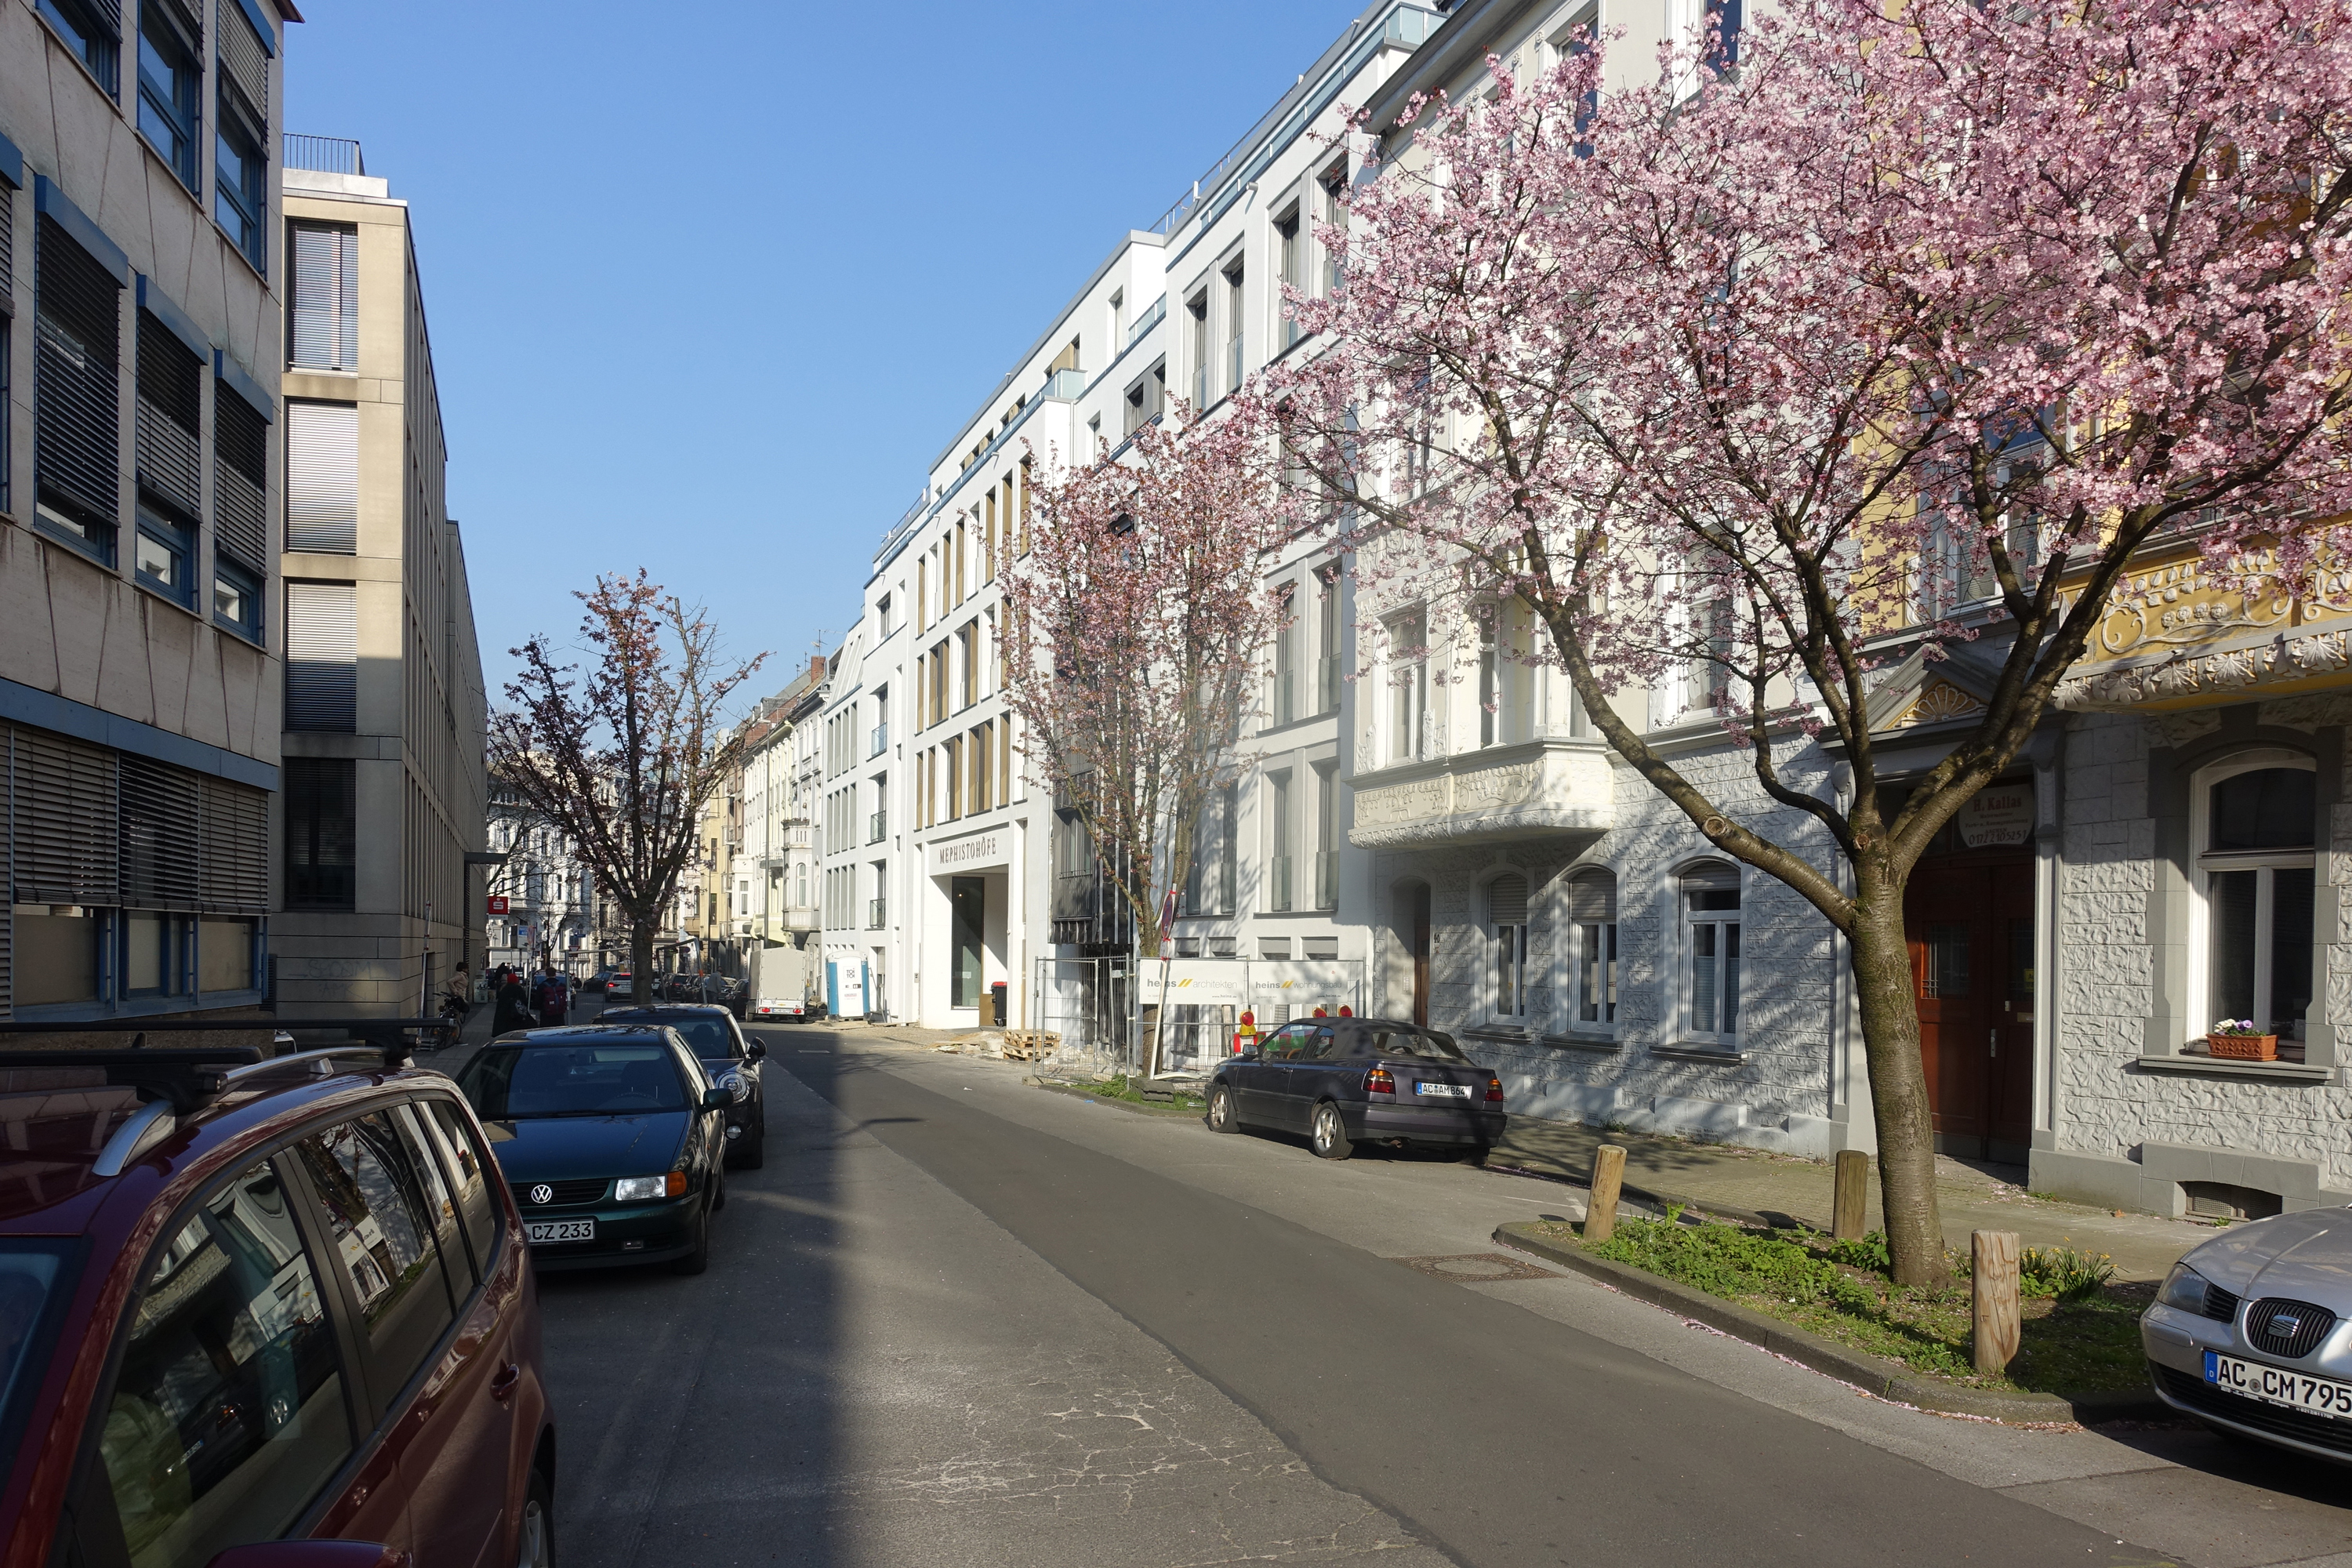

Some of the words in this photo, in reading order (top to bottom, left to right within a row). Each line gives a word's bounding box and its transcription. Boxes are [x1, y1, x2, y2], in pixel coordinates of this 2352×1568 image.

[939, 836, 996, 864] MEPHISTOHÖFE
[1147, 978, 1177, 987] hens
[1192, 980, 1238, 989] architekten
[1293, 981, 1342, 990] wohnungsbau
[1423, 1084, 1433, 1094] AC
[1439, 1085, 1450, 1094] AM
[1450, 1086, 1465, 1096] 864
[532, 1225, 554, 1240] CZ
[559, 1222, 591, 1239] 233
[2218, 1359, 2246, 1387] AC
[2263, 1370, 2295, 1401] CM
[2302, 1378, 2352, 1414] 795
